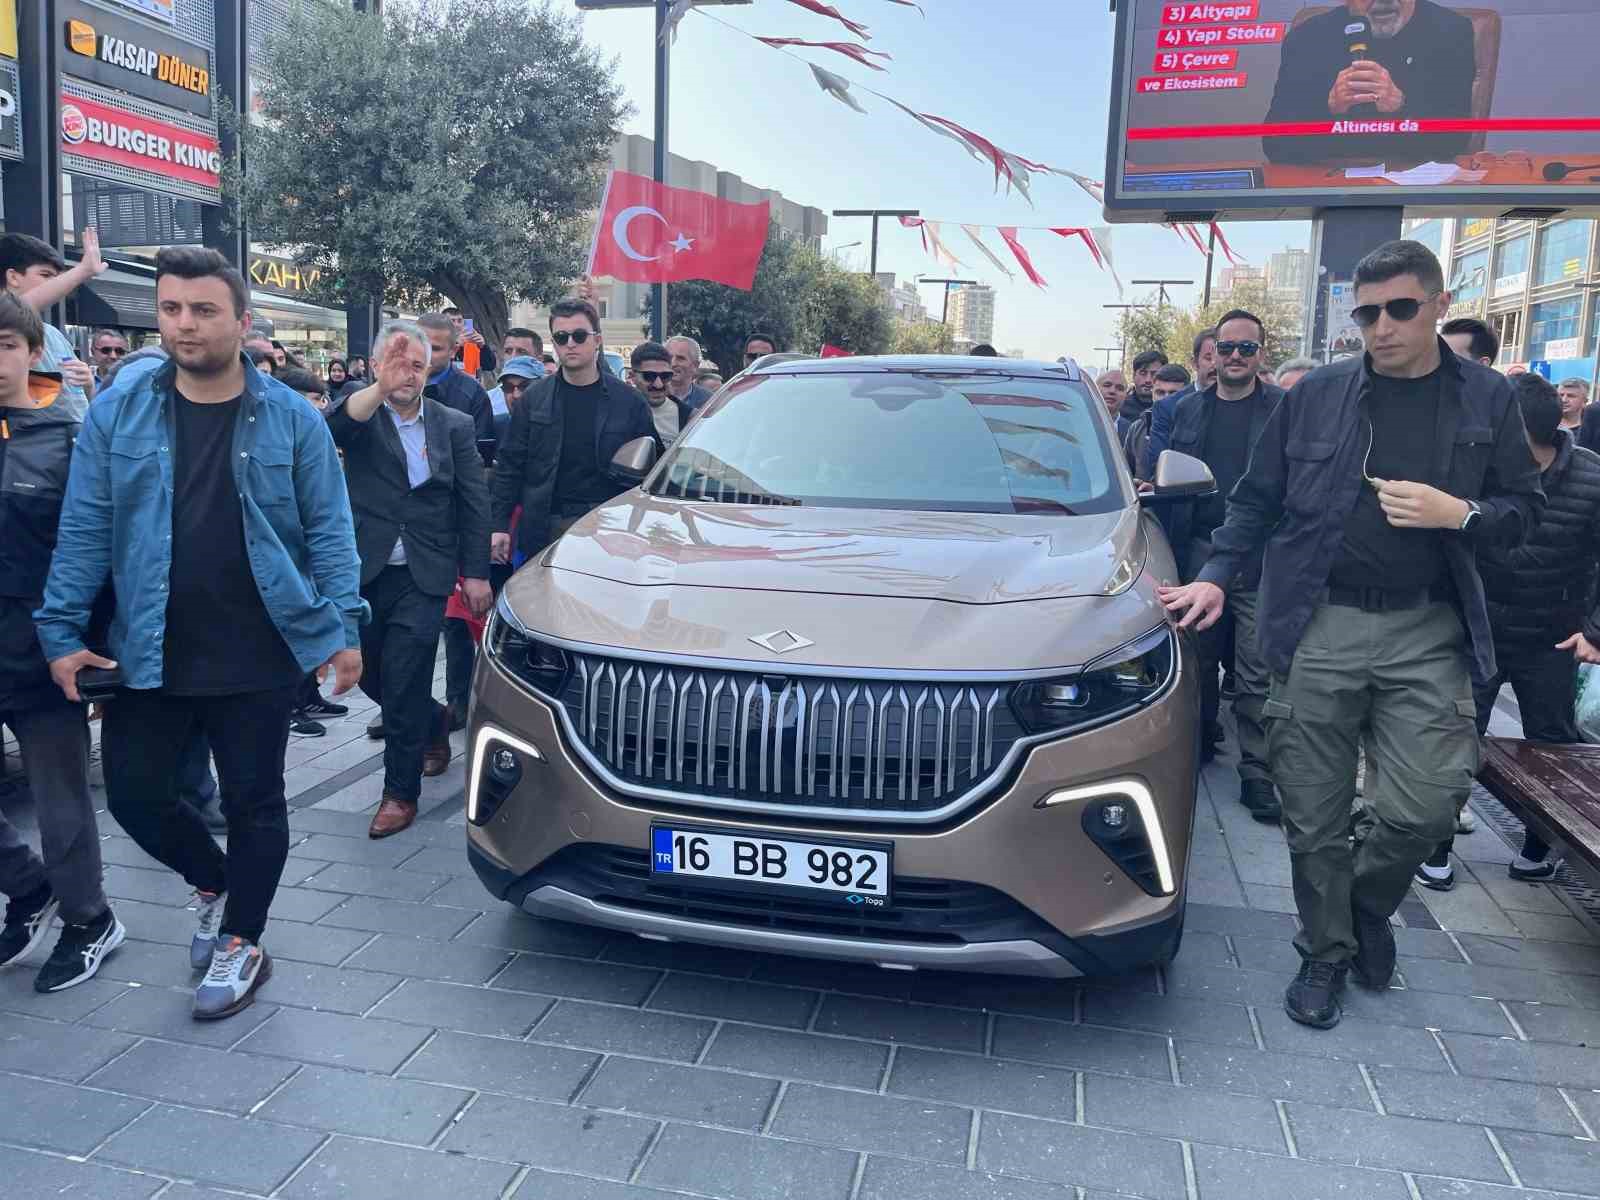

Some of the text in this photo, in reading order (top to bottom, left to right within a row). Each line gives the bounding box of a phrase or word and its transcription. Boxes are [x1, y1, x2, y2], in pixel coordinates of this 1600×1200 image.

[1169, 5, 1251, 21] 3) Altyapı
[1165, 26, 1277, 45] 4) Yapı Stoku
[1161, 53, 1230, 70] 5) Çevre
[1144, 76, 1238, 91] ve Ekosistem
[1331, 119, 1419, 134] Altıncısı da
[88, 117, 171, 161] BURGER
[173, 141, 220, 174] KING
[656, 835, 878, 891] TR 16 BB 982
